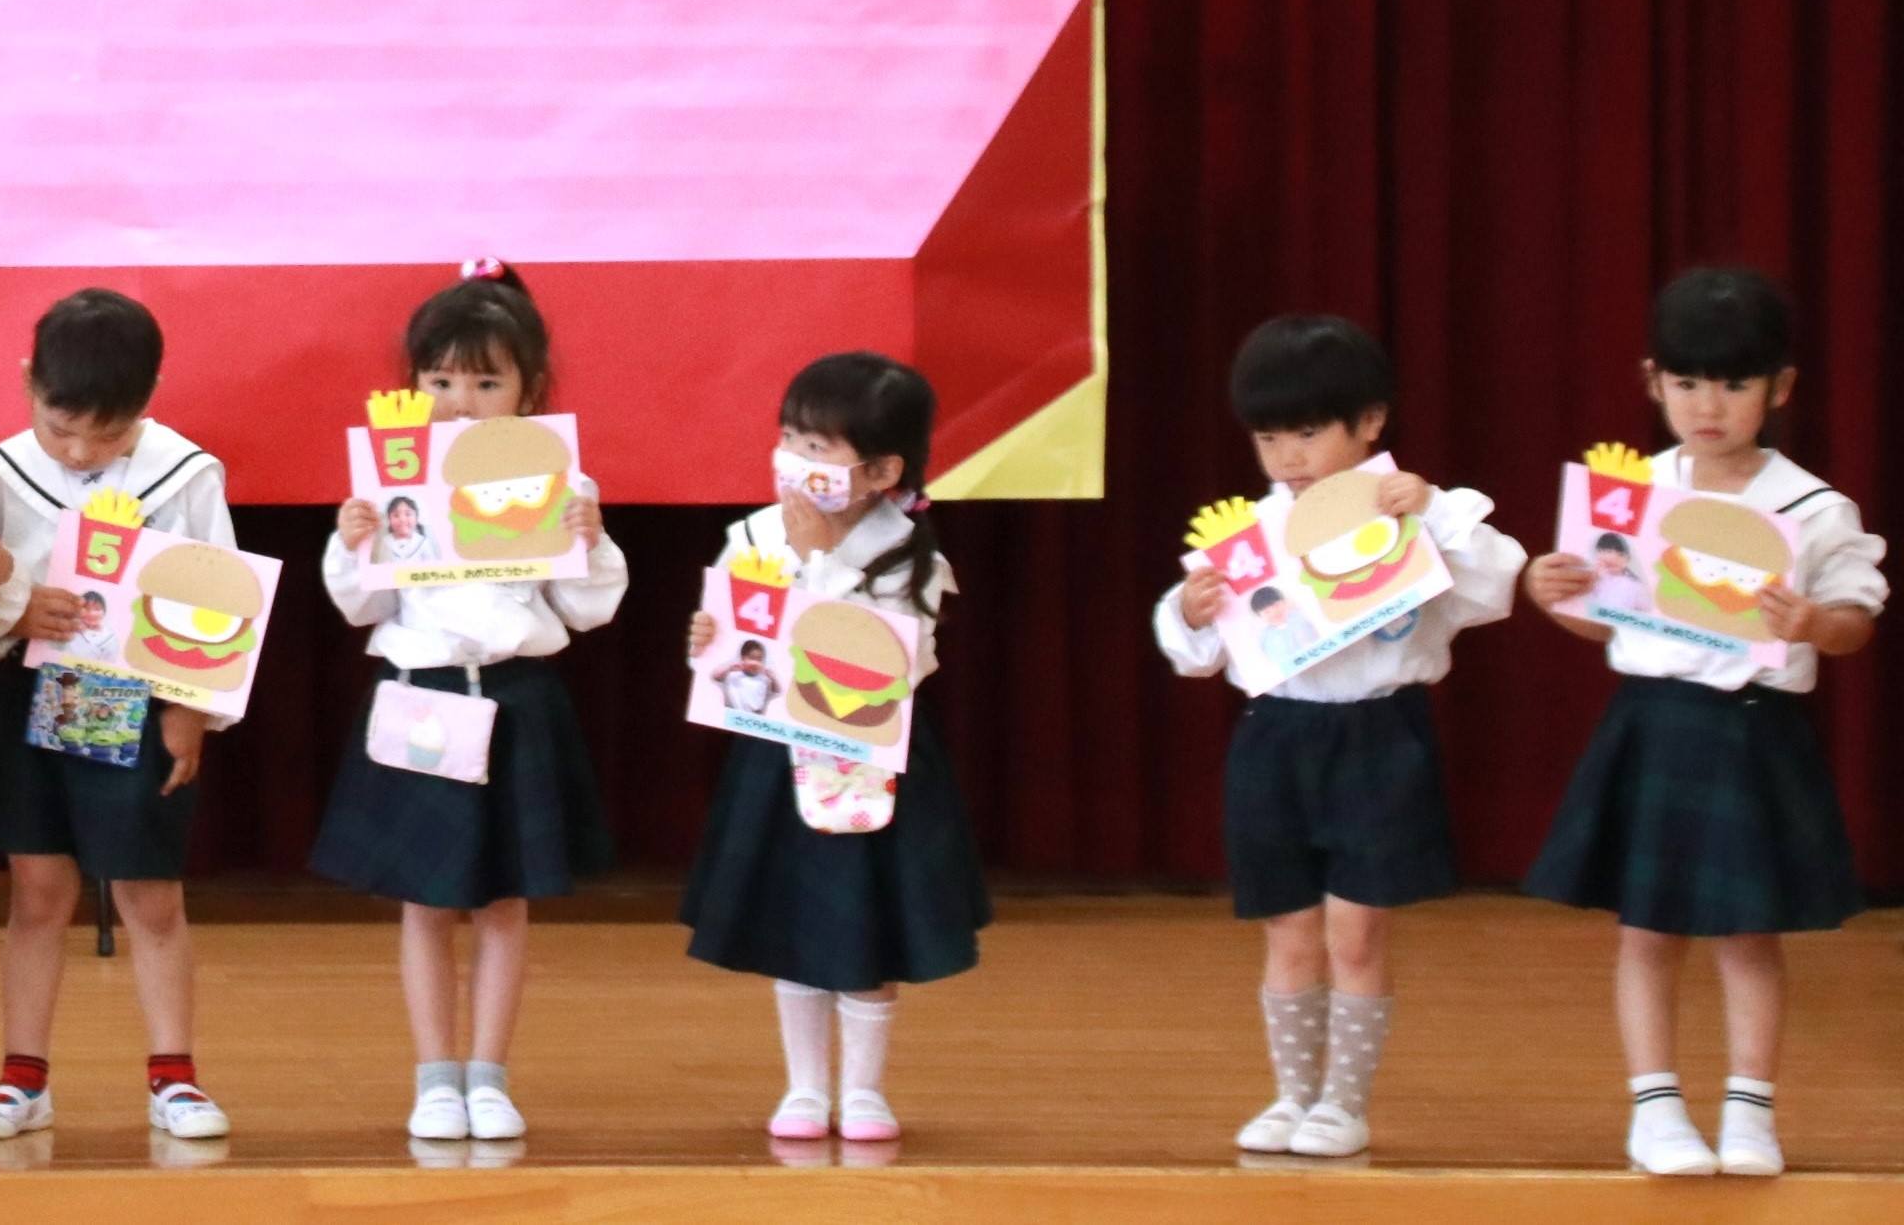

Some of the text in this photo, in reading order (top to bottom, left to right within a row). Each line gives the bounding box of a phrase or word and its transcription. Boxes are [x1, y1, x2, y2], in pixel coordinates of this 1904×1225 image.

[384, 437, 420, 480] 5
[1596, 487, 1635, 525] 4
[85, 531, 122, 575] 5
[1227, 540, 1266, 581] 4
[738, 591, 775, 631] 4
